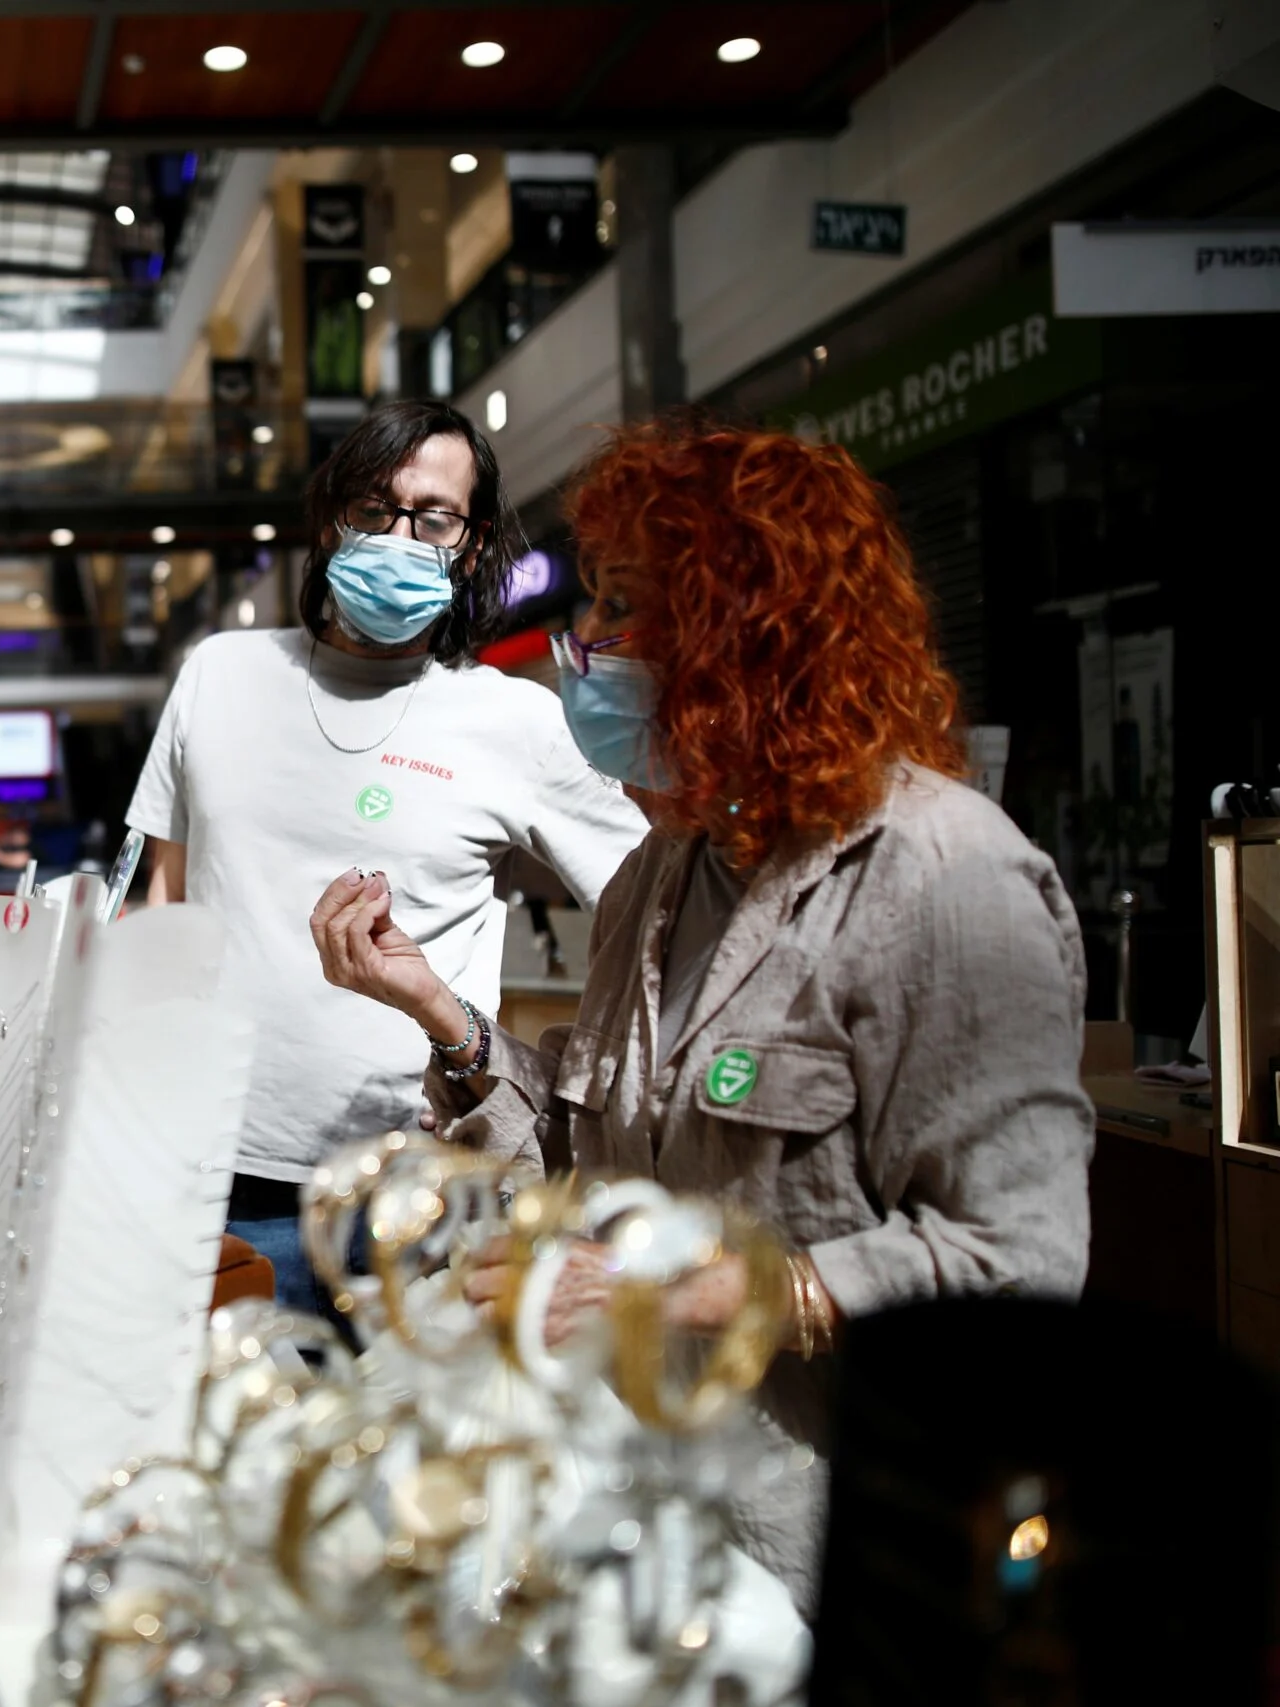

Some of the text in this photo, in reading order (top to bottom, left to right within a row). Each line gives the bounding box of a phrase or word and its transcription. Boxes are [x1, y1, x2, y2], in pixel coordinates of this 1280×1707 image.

[826, 312, 1049, 446] YVES ROCHER
[380, 753, 454, 781] KEY ISSUES
